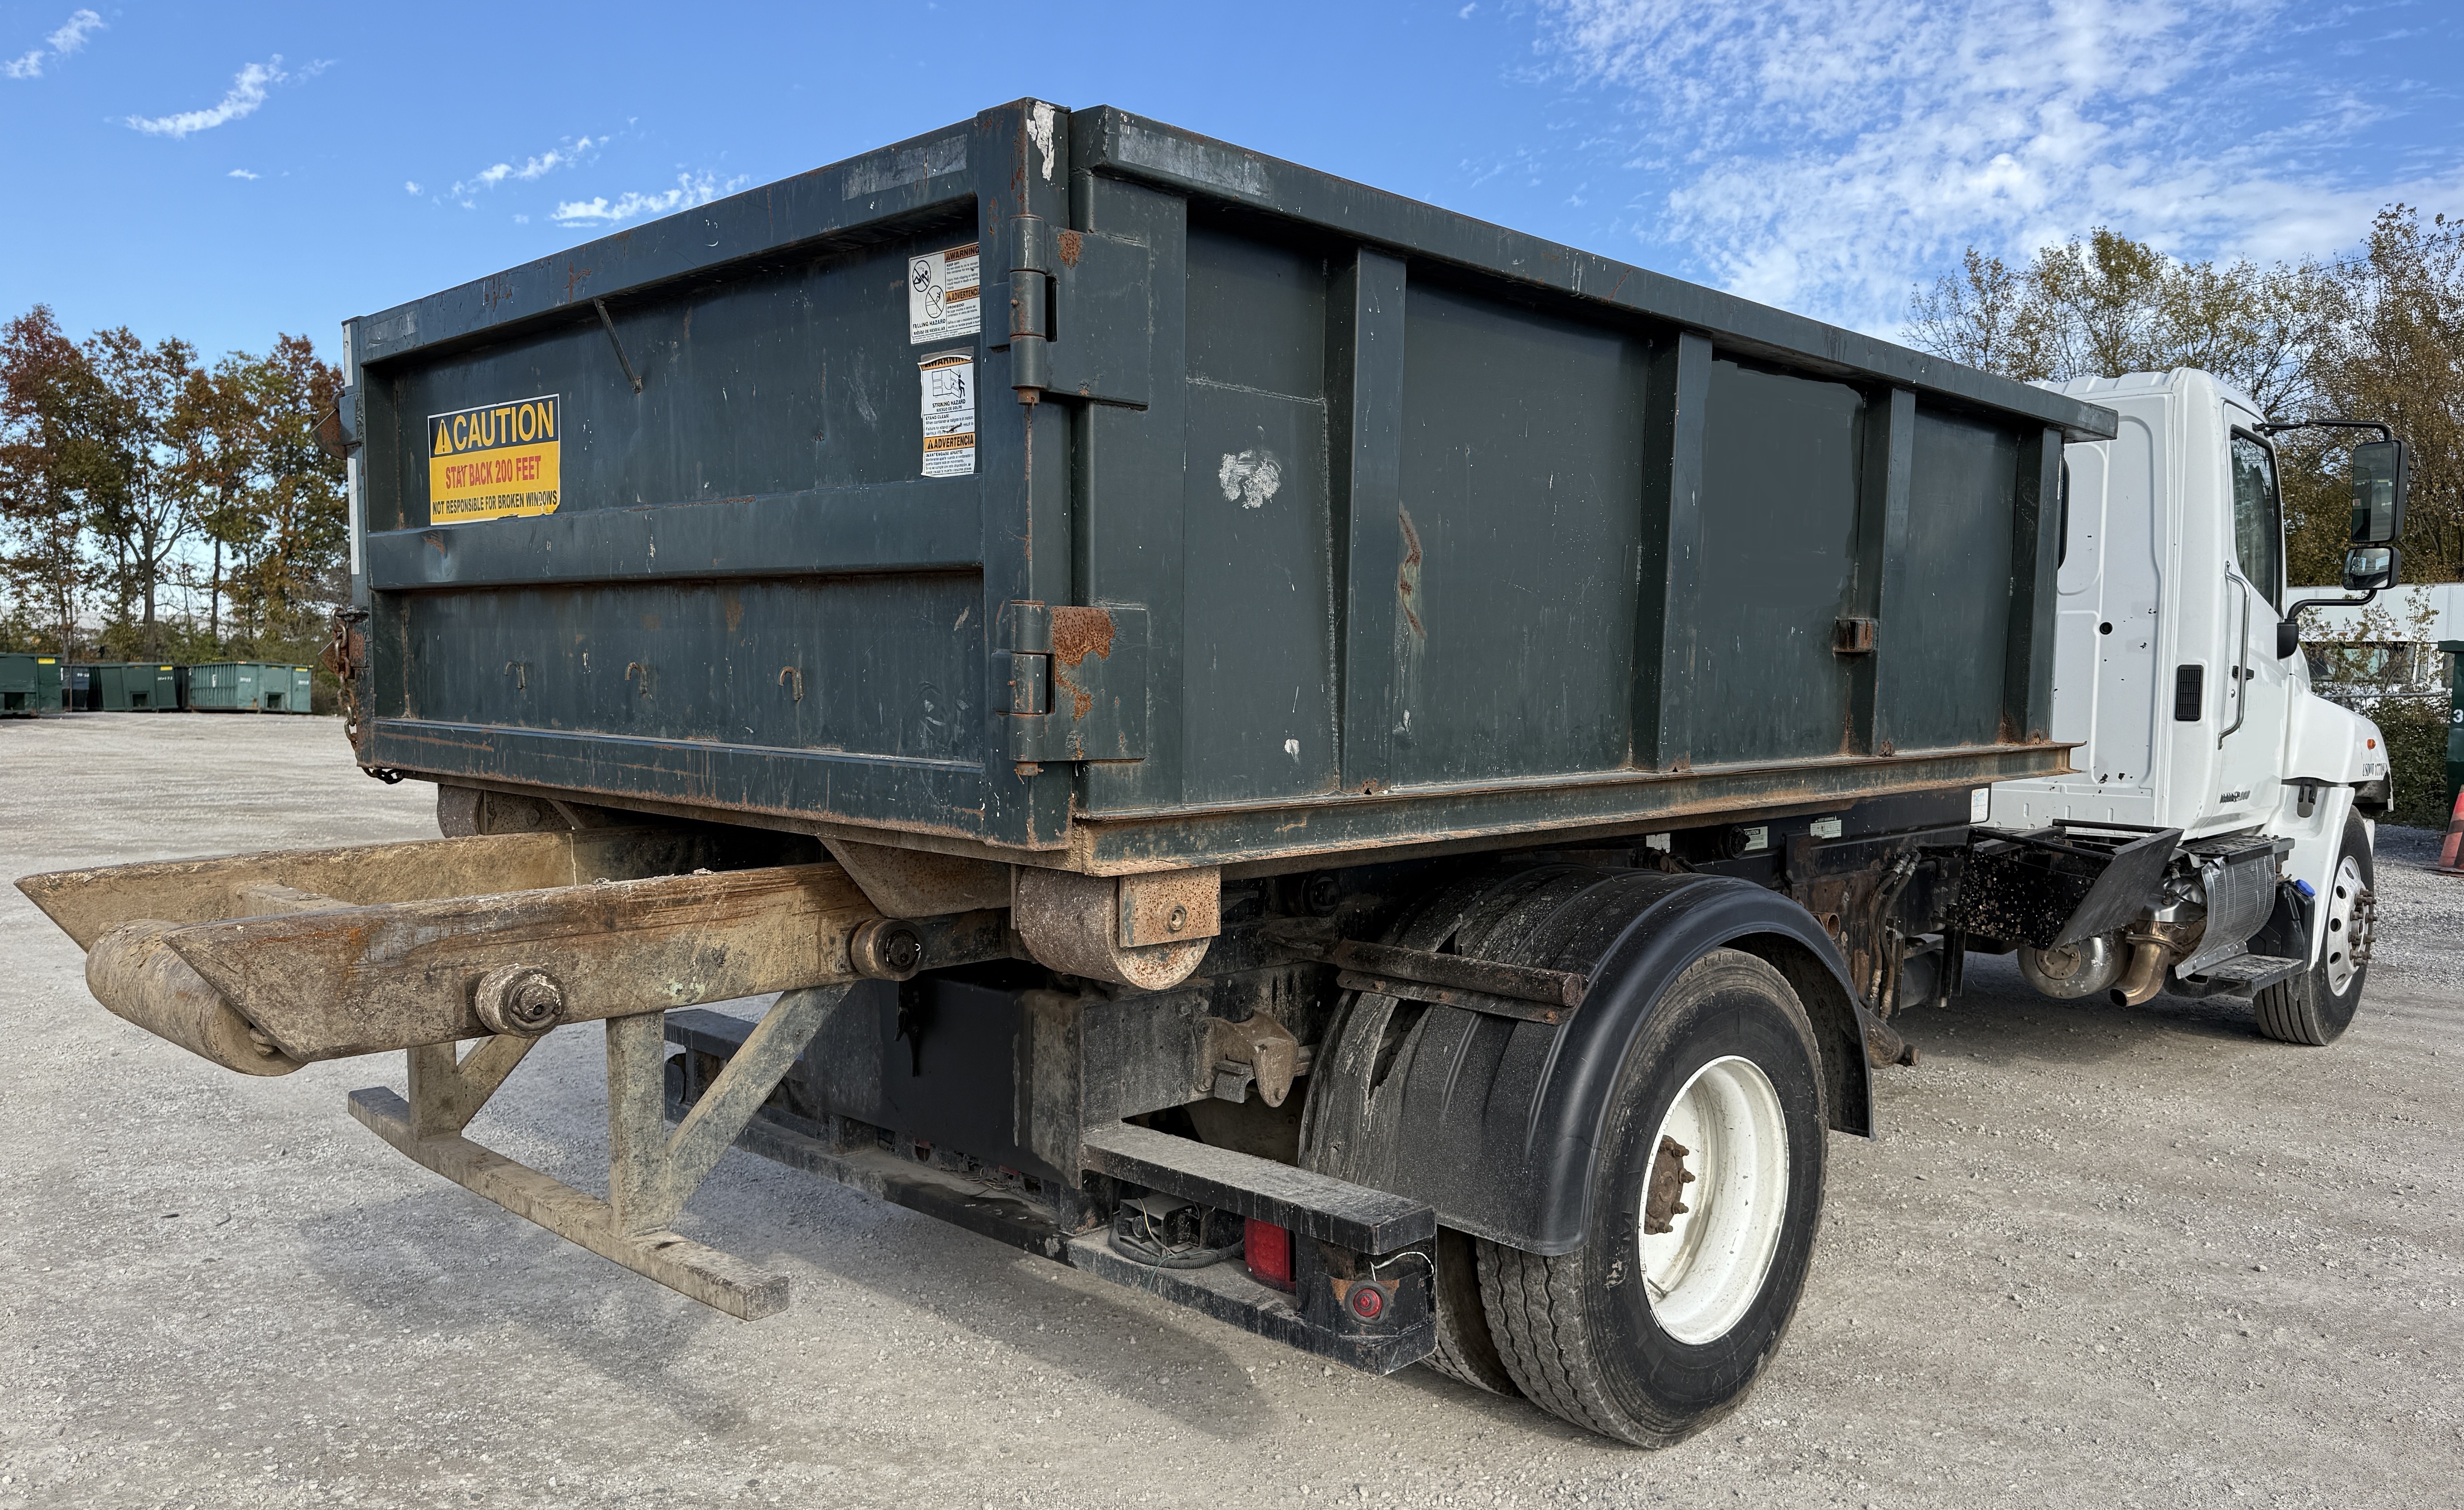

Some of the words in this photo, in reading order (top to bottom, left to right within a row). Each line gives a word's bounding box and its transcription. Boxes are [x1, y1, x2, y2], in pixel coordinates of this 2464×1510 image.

[950, 246, 979, 259] WARNING
[453, 401, 554, 450] CAUTION
[934, 435, 974, 449] ADVERTENCIA
[446, 465, 466, 490] STAY
[469, 461, 493, 486] BACK
[496, 458, 512, 483] 200
[516, 455, 541, 481] FEET
[433, 501, 444, 515] NOT
[446, 497, 484, 514] RESPONSIBLE
[486, 495, 496, 510] FOR
[498, 493, 524, 509] BROKEN
[526, 490, 557, 506] WINDOWS
